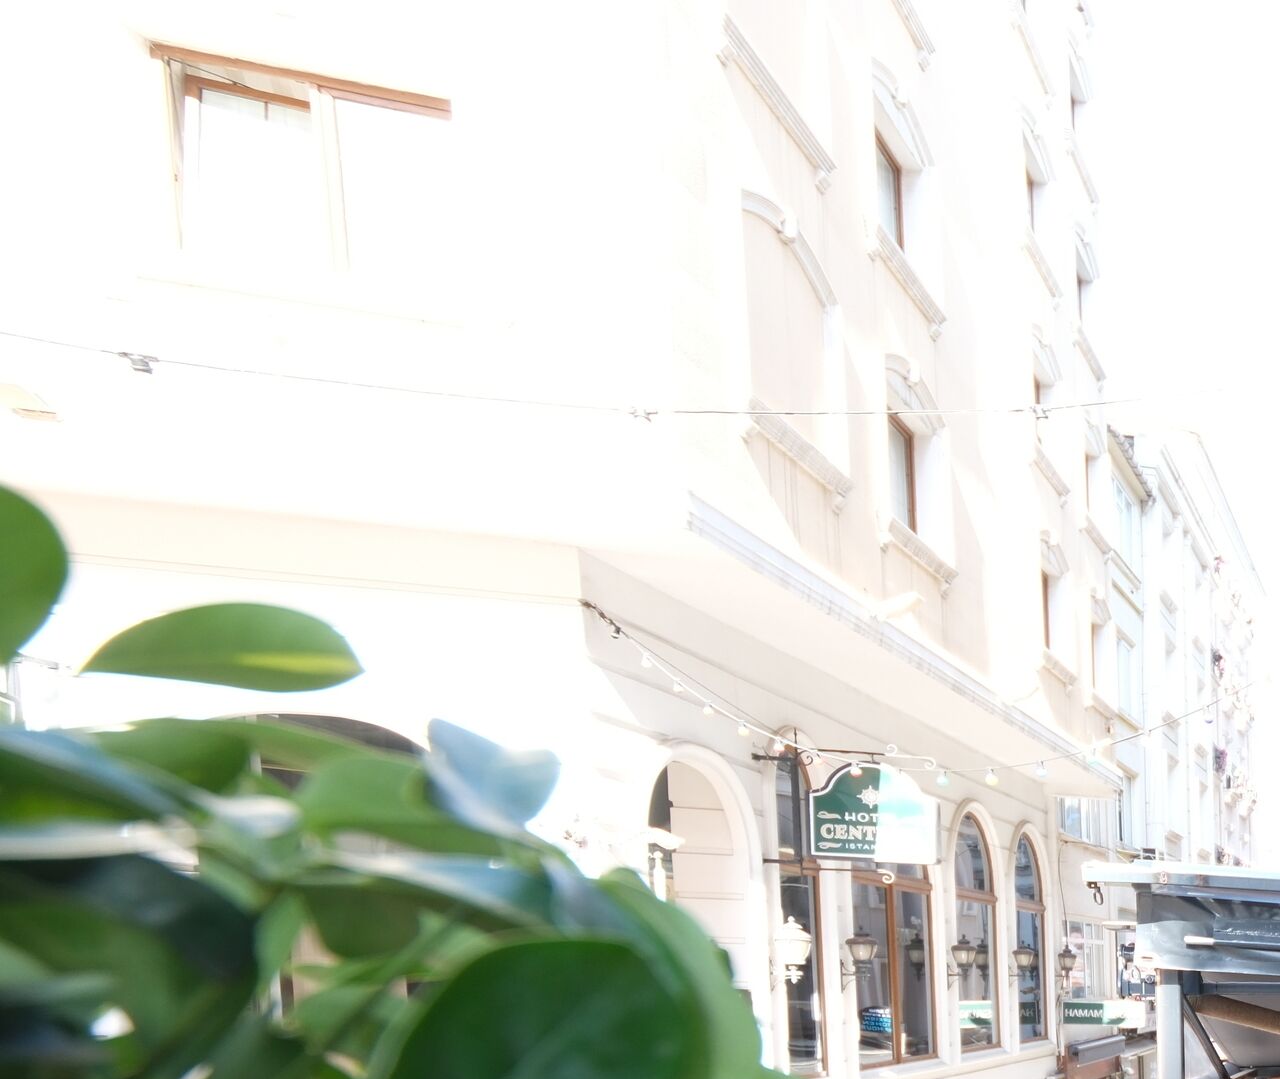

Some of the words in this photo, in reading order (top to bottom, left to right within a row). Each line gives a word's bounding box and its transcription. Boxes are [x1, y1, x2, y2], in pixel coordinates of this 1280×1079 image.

[844, 812, 880, 823] HOT
[820, 823, 877, 841] CENT
[1065, 1009, 1102, 1018] HAMAM
